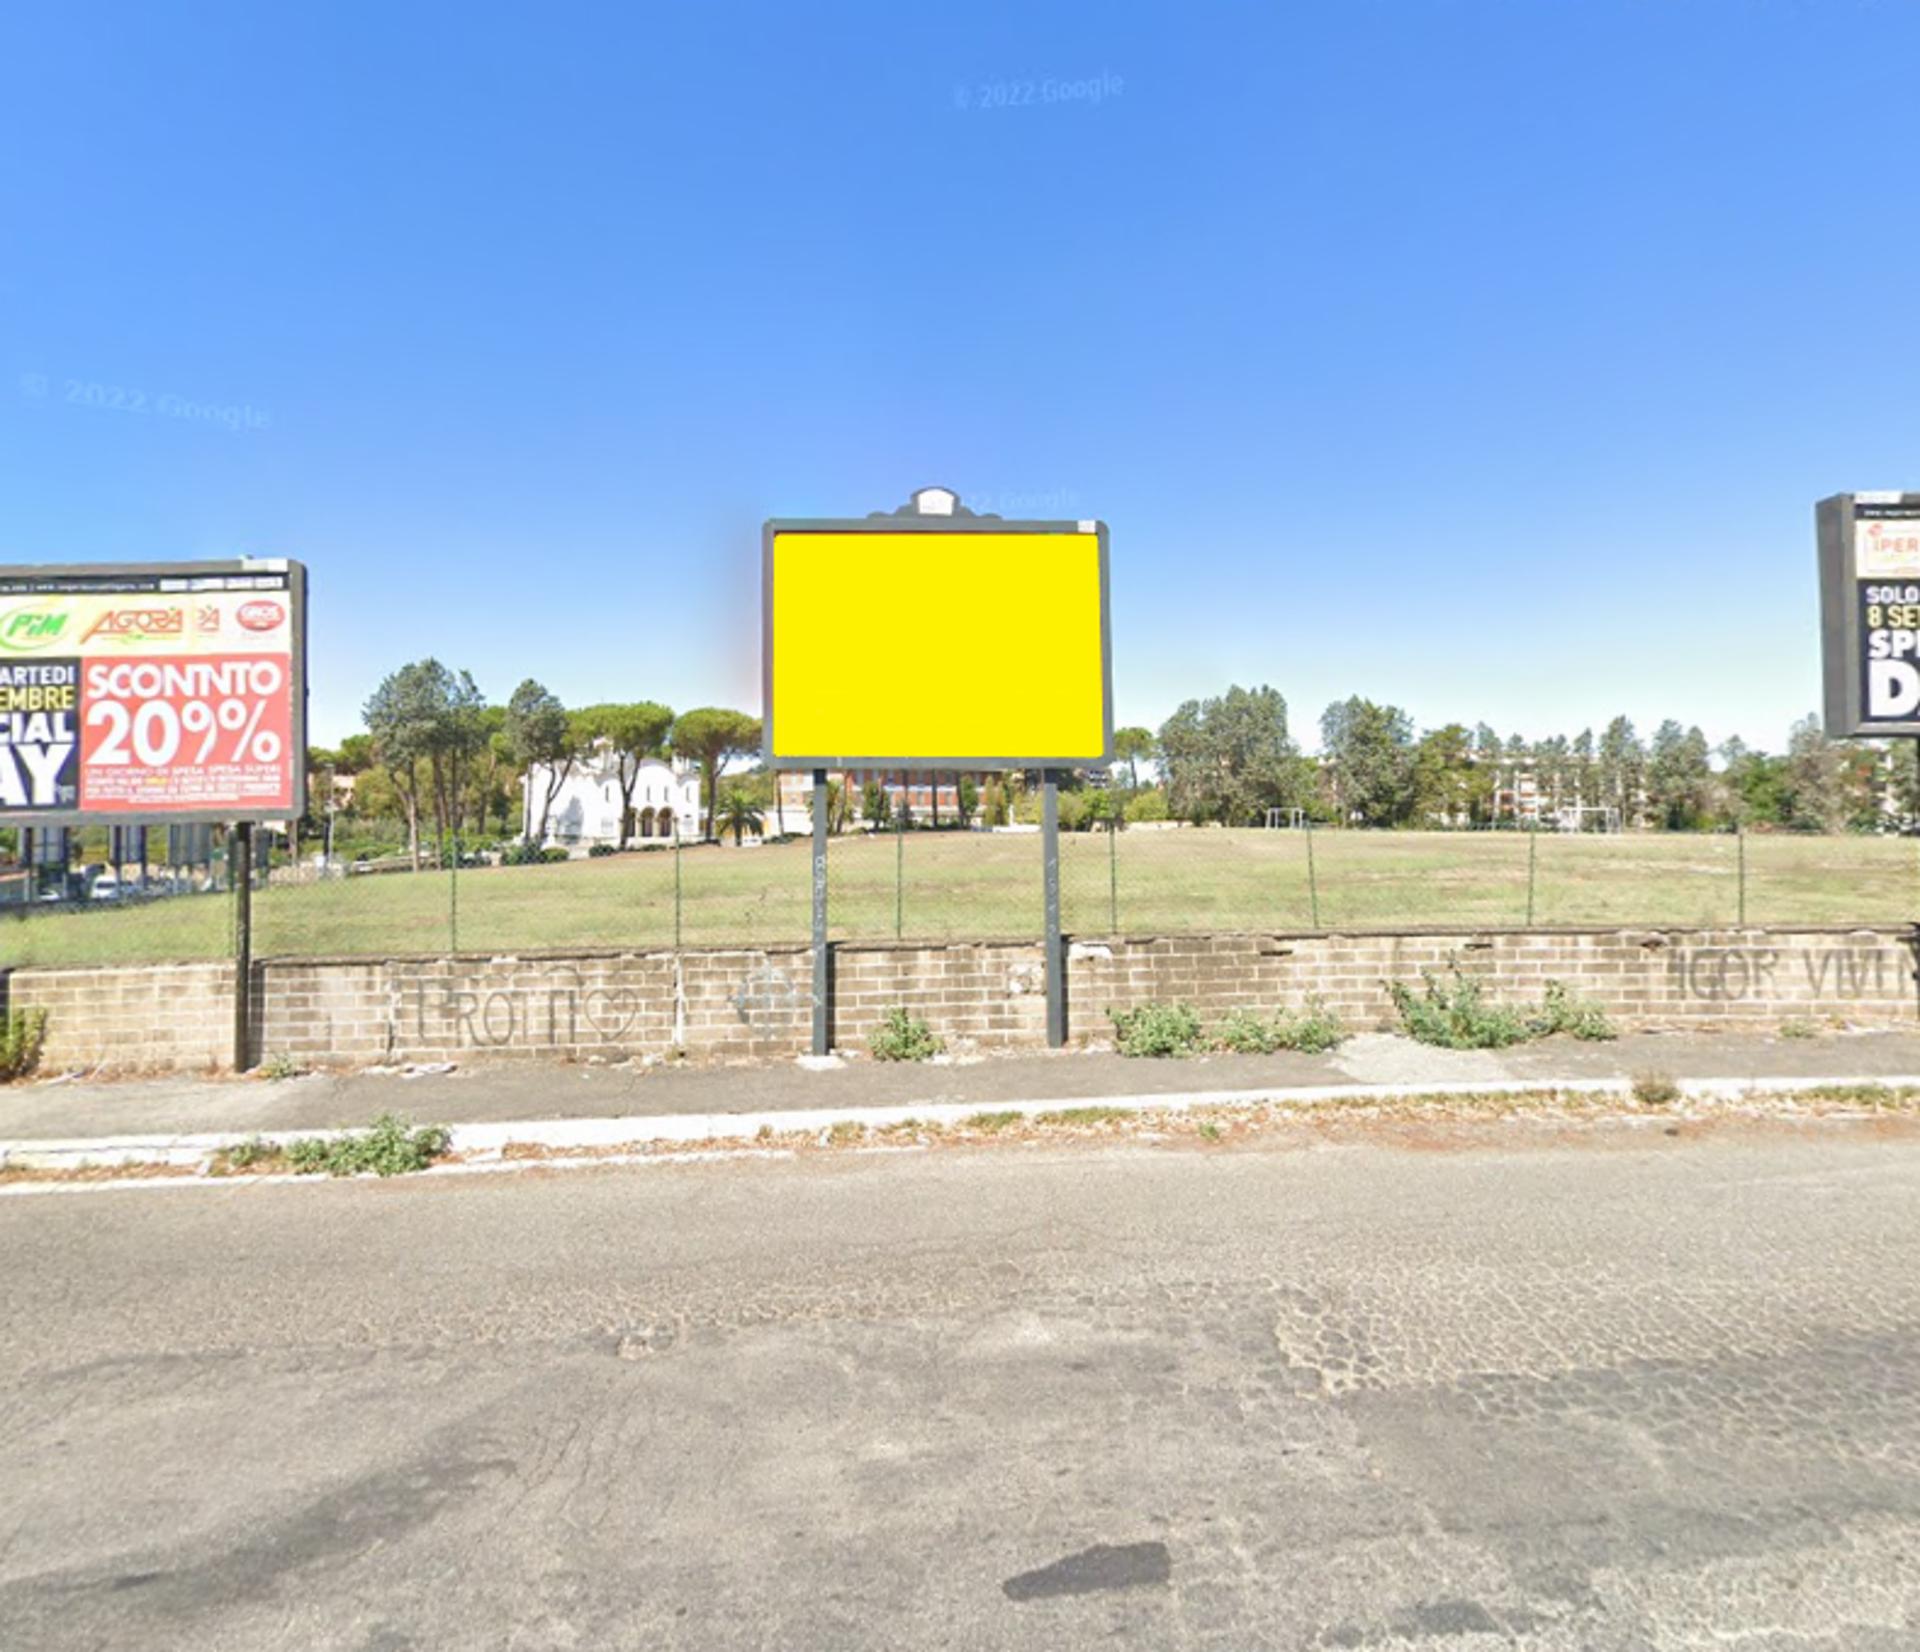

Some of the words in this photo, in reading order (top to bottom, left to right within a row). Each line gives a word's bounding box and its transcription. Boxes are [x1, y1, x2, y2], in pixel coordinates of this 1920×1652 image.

[1866, 585, 1919, 604] SOLO
[1867, 605, 1883, 628] 8
[1887, 605, 1920, 628] SE
[1869, 660, 1920, 716] D
